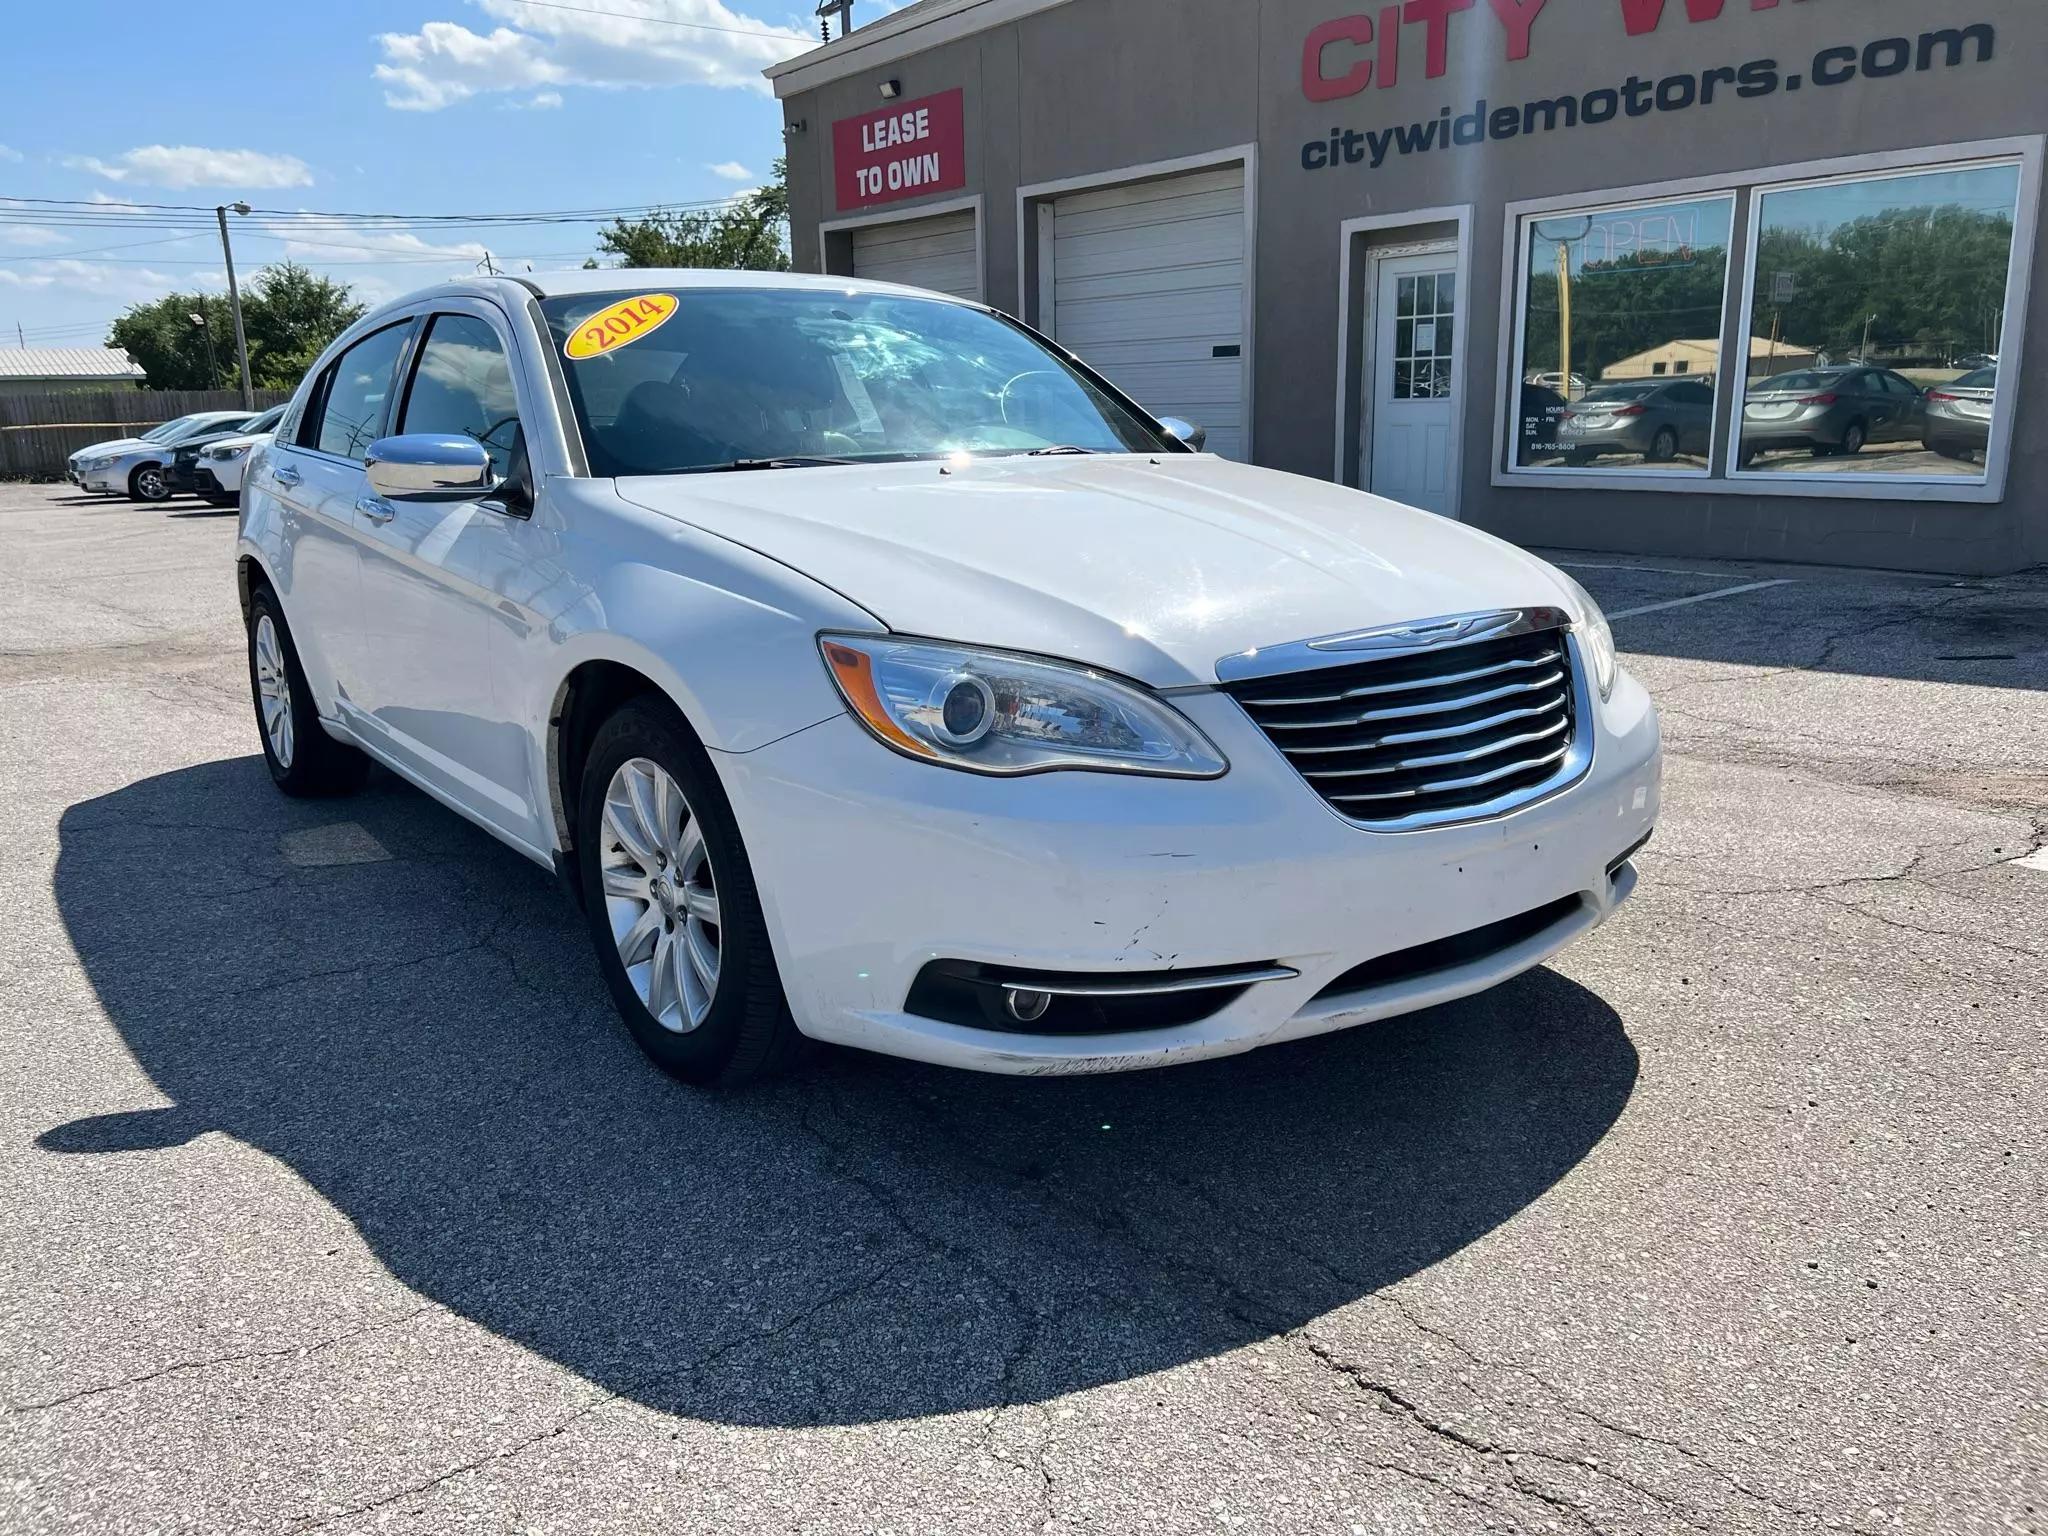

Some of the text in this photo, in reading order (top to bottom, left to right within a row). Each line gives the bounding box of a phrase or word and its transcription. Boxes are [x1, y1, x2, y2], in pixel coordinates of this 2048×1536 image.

[1302, 0, 1546, 102] CITY
[1301, 23, 1994, 170] citywidemotors.com
[862, 108, 929, 153] LEASE
[856, 152, 939, 197] TO OWN
[1584, 215, 1694, 268] OPEN
[585, 299, 664, 349] 2014
